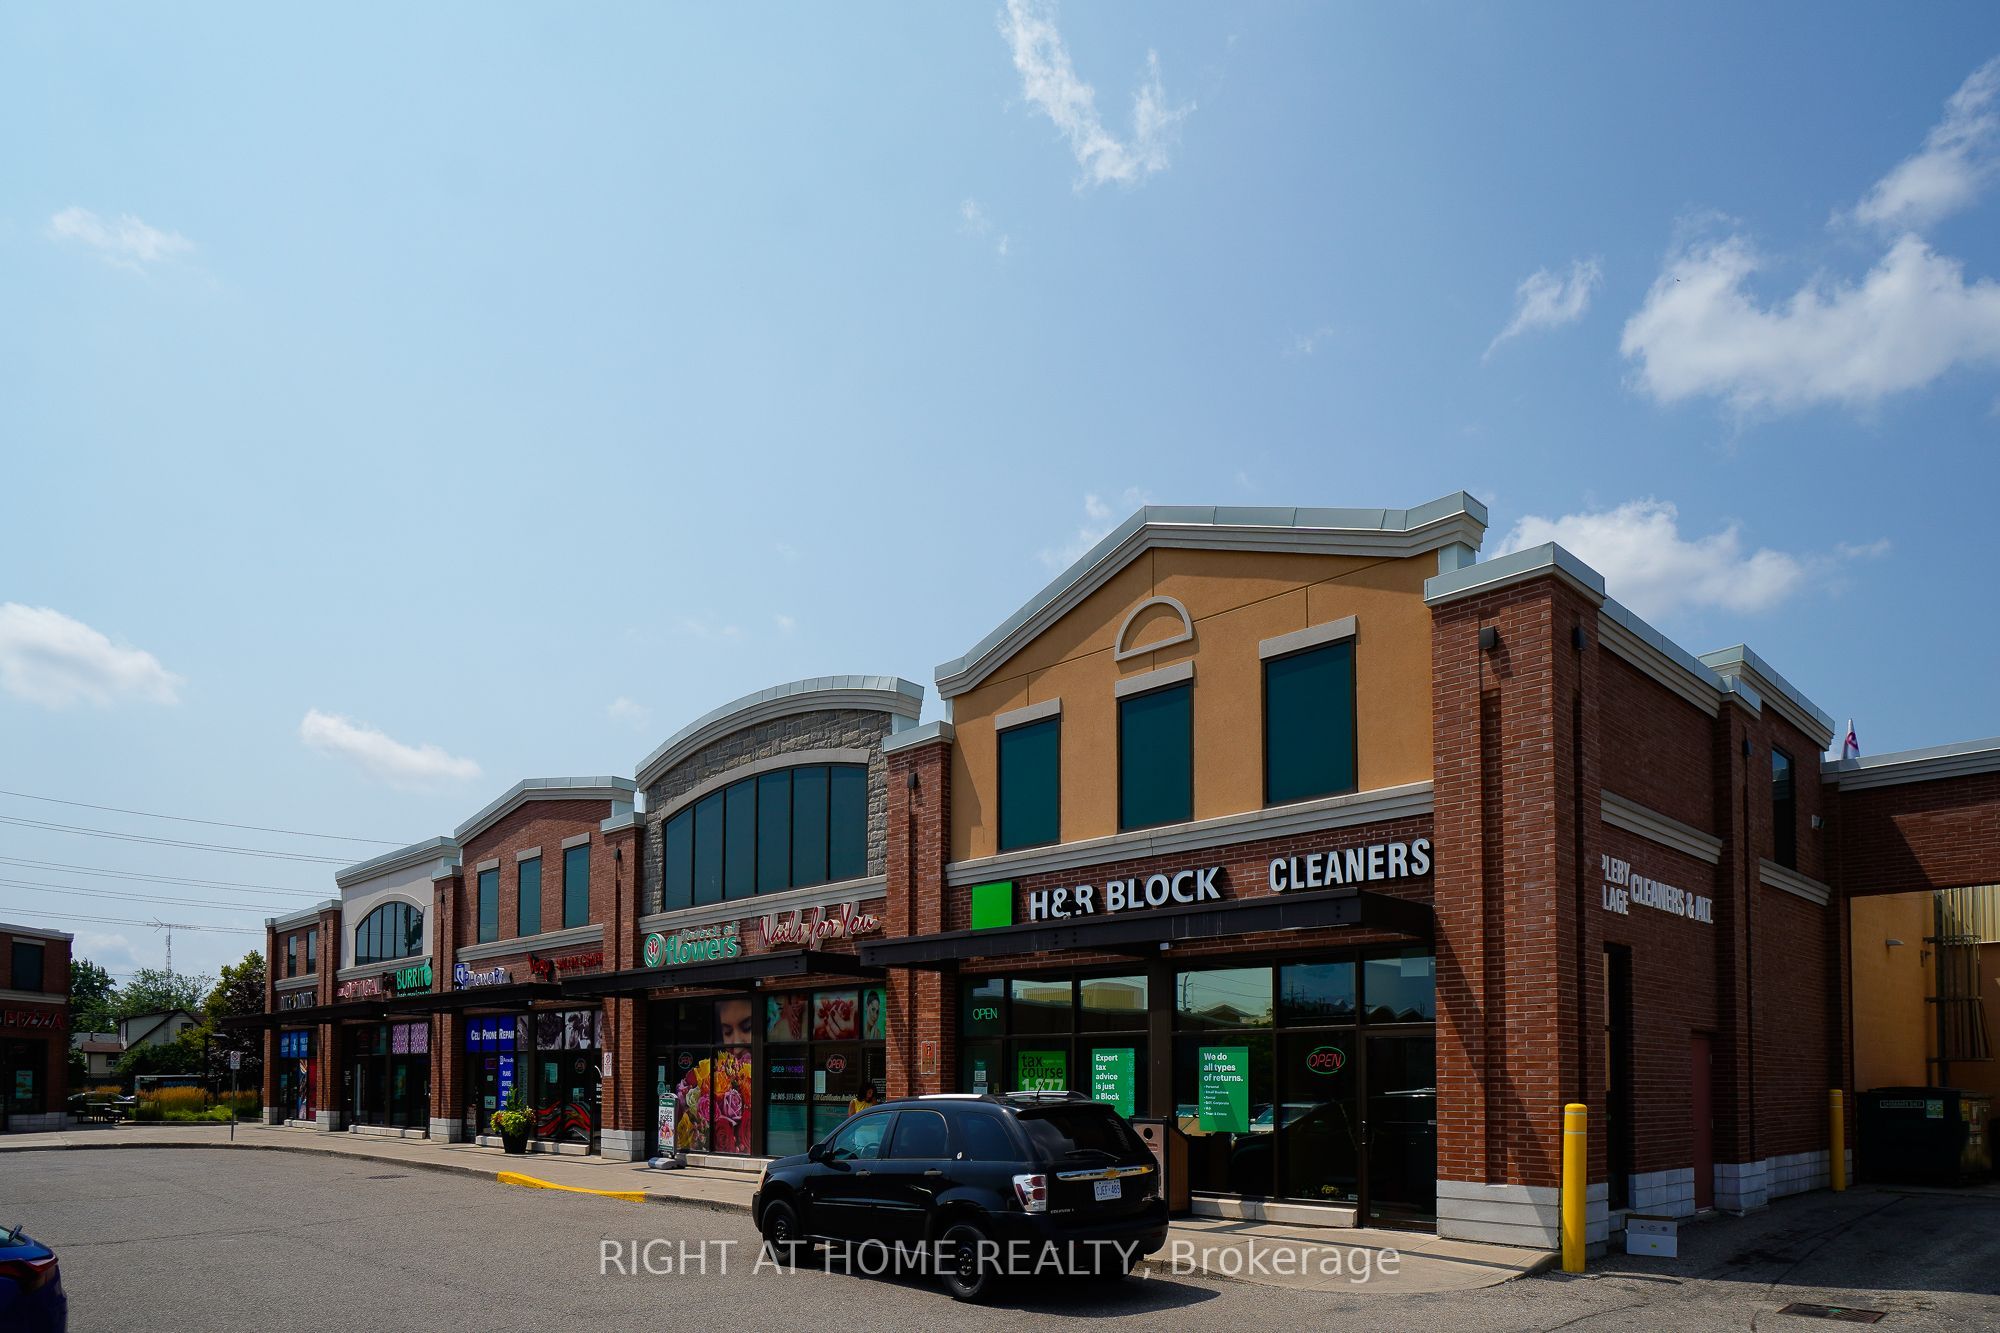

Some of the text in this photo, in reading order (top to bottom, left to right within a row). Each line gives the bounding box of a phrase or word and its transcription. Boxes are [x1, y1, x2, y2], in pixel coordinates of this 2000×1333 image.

[1268, 838, 1432, 892] CLEANERS
[1029, 867, 1222, 921] H&R BLOCK
[1630, 873, 1685, 917] CLEANERS
[1685, 892, 1695, 919] &
[758, 903, 878, 950] Nails for You
[665, 935, 739, 964] flowers
[396, 963, 432, 990] BURRITO
[343, 977, 382, 998] OPTICAL
[4, 1008, 65, 1029] PIZZA
[973, 1008, 998, 1020] OPEN
[827, 1058, 846, 1070] OPEN
[1022, 1055, 1043, 1067] tax
[1096, 1054, 1118, 1063] Expert
[1309, 1053, 1342, 1067] OPEN
[1022, 1067, 1063, 1078] course
[1204, 1063, 1236, 1072] all types
[1102, 1083, 1115, 1091] just
